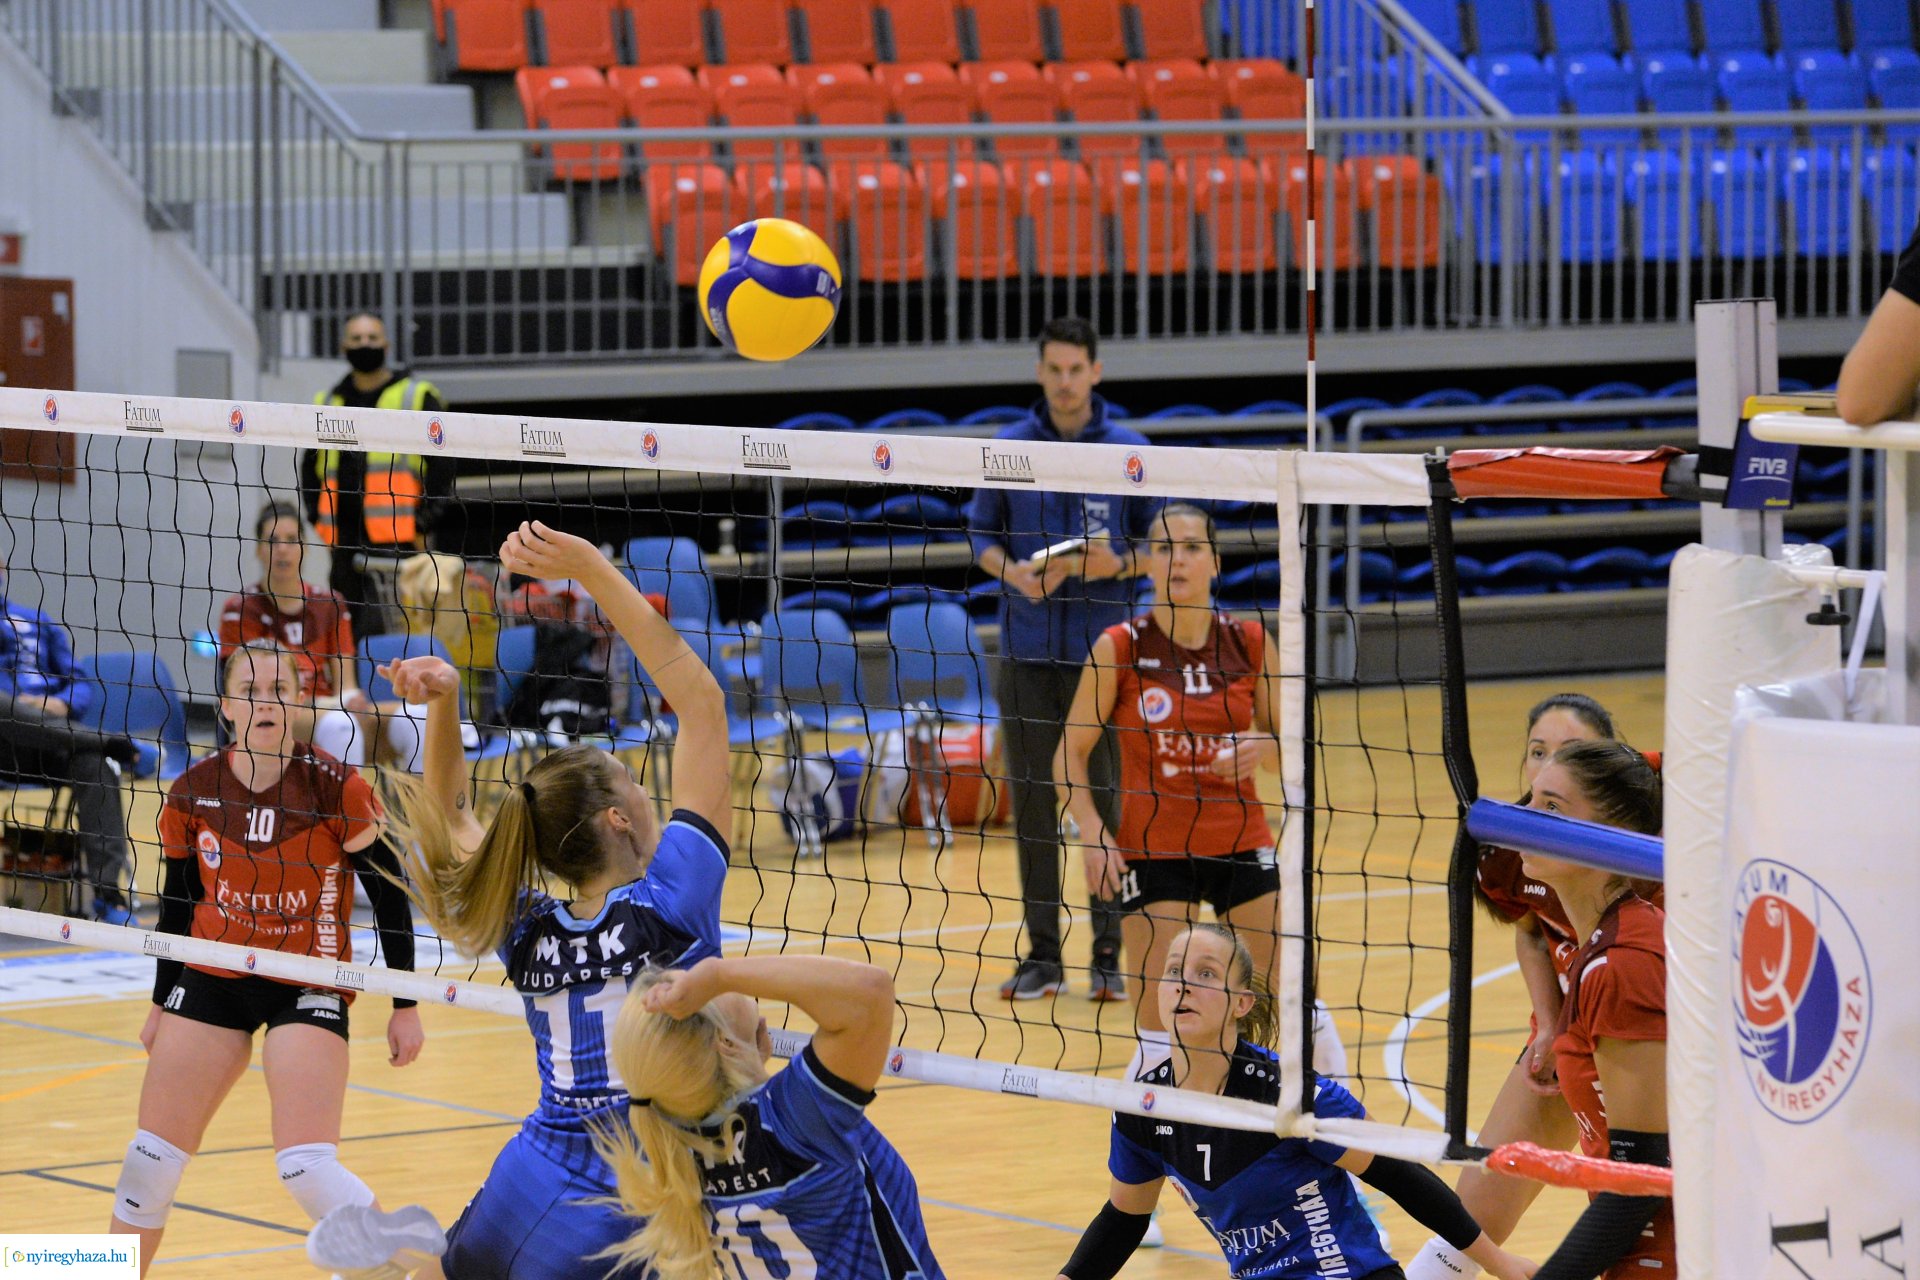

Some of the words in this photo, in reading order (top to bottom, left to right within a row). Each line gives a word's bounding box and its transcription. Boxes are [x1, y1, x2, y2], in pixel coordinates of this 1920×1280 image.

[124, 400, 161, 422] FATUM
[315, 412, 355, 434] FATUM
[519, 423, 563, 446] FATUM
[741, 434, 788, 458] FATUM
[981, 446, 1032, 471] FATUM
[1182, 663, 1213, 694] 11
[245, 807, 275, 843] 10
[1523, 884, 1546, 896] JAKO
[143, 934, 171, 952] FATUM
[536, 923, 626, 966] MTK
[335, 965, 365, 984] FATUM
[534, 976, 628, 1090] 11
[1001, 1068, 1038, 1089] FATUM
[1196, 1144, 1211, 1181] 7
[706, 1167, 771, 1194] APEST
